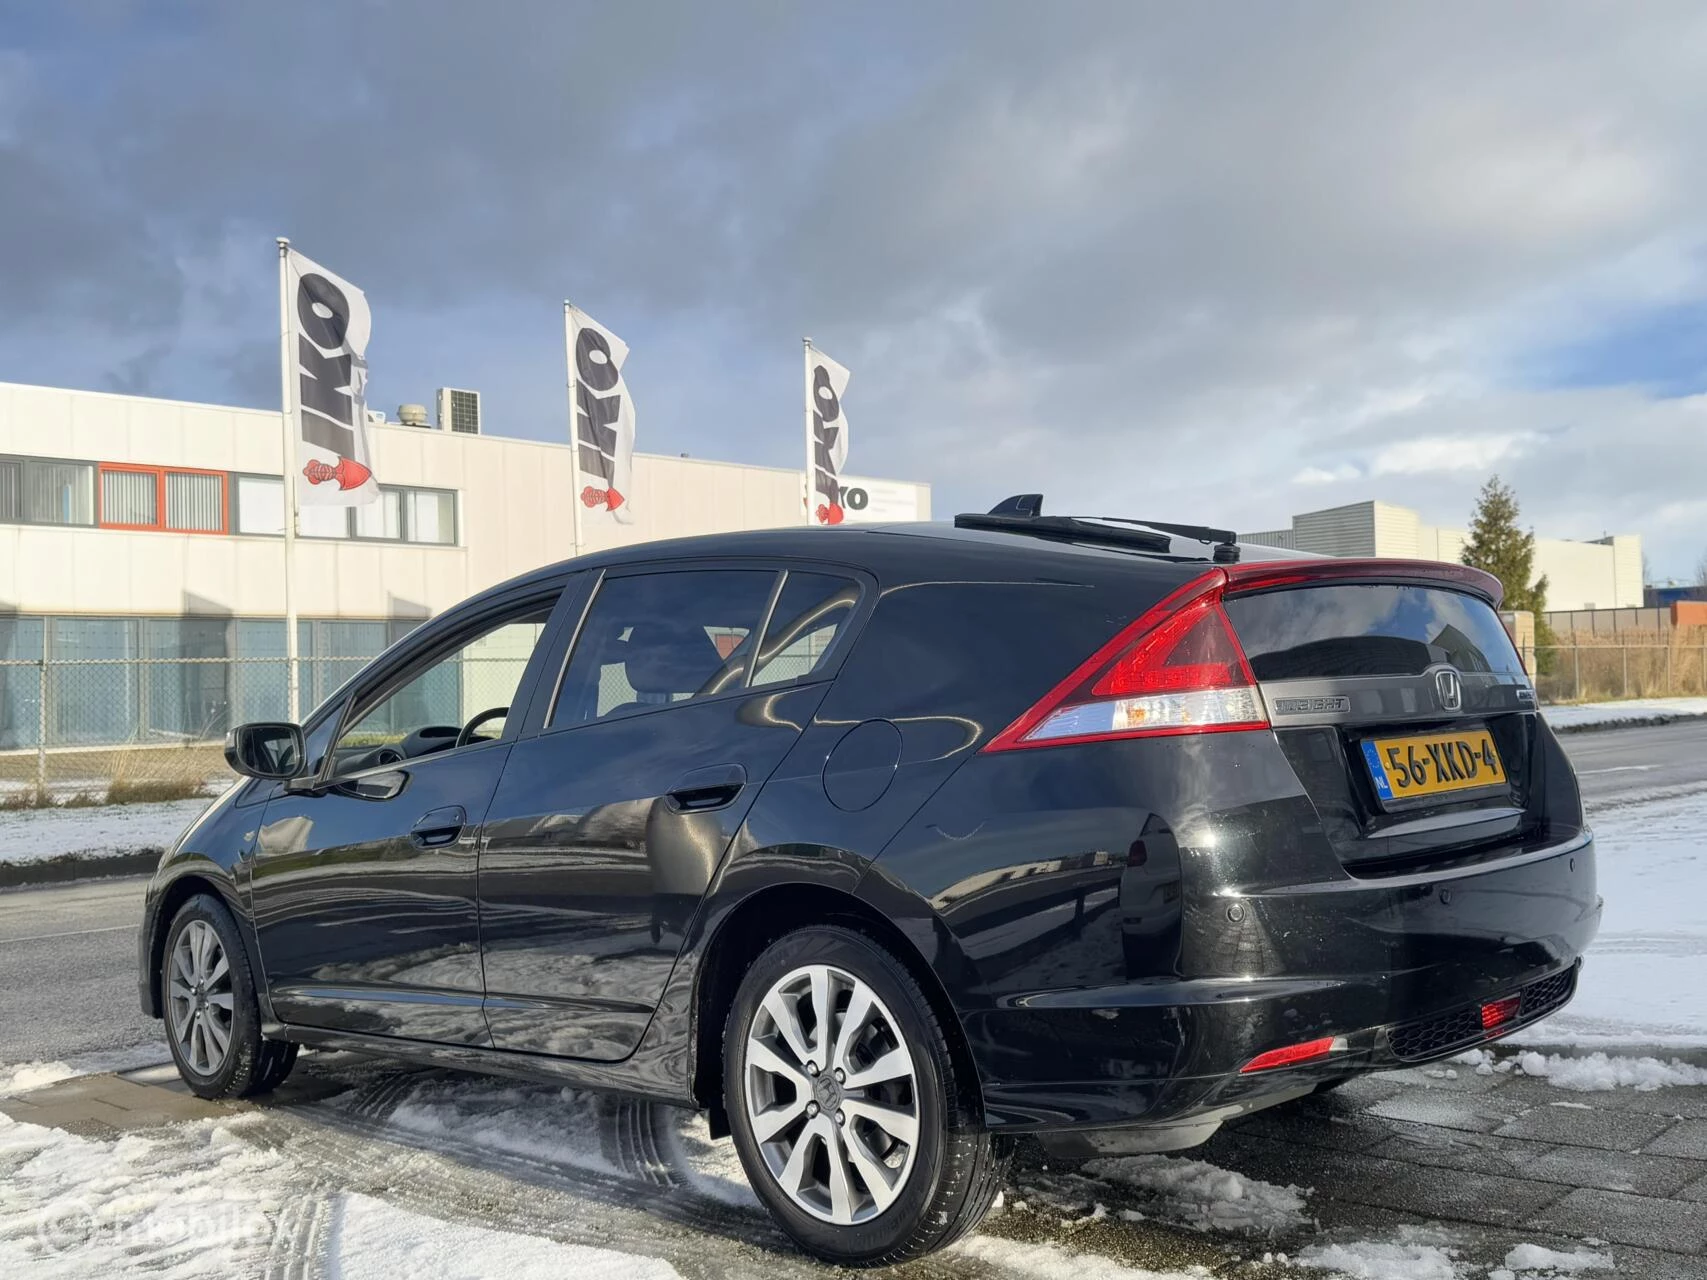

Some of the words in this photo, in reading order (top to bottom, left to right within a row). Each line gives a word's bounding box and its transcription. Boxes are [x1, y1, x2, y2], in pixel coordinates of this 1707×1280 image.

[297, 273, 355, 460] IKO
[576, 328, 621, 488] IKO
[1374, 776, 1388, 789] NL
[1386, 739, 1497, 788] 56-XKD-4
